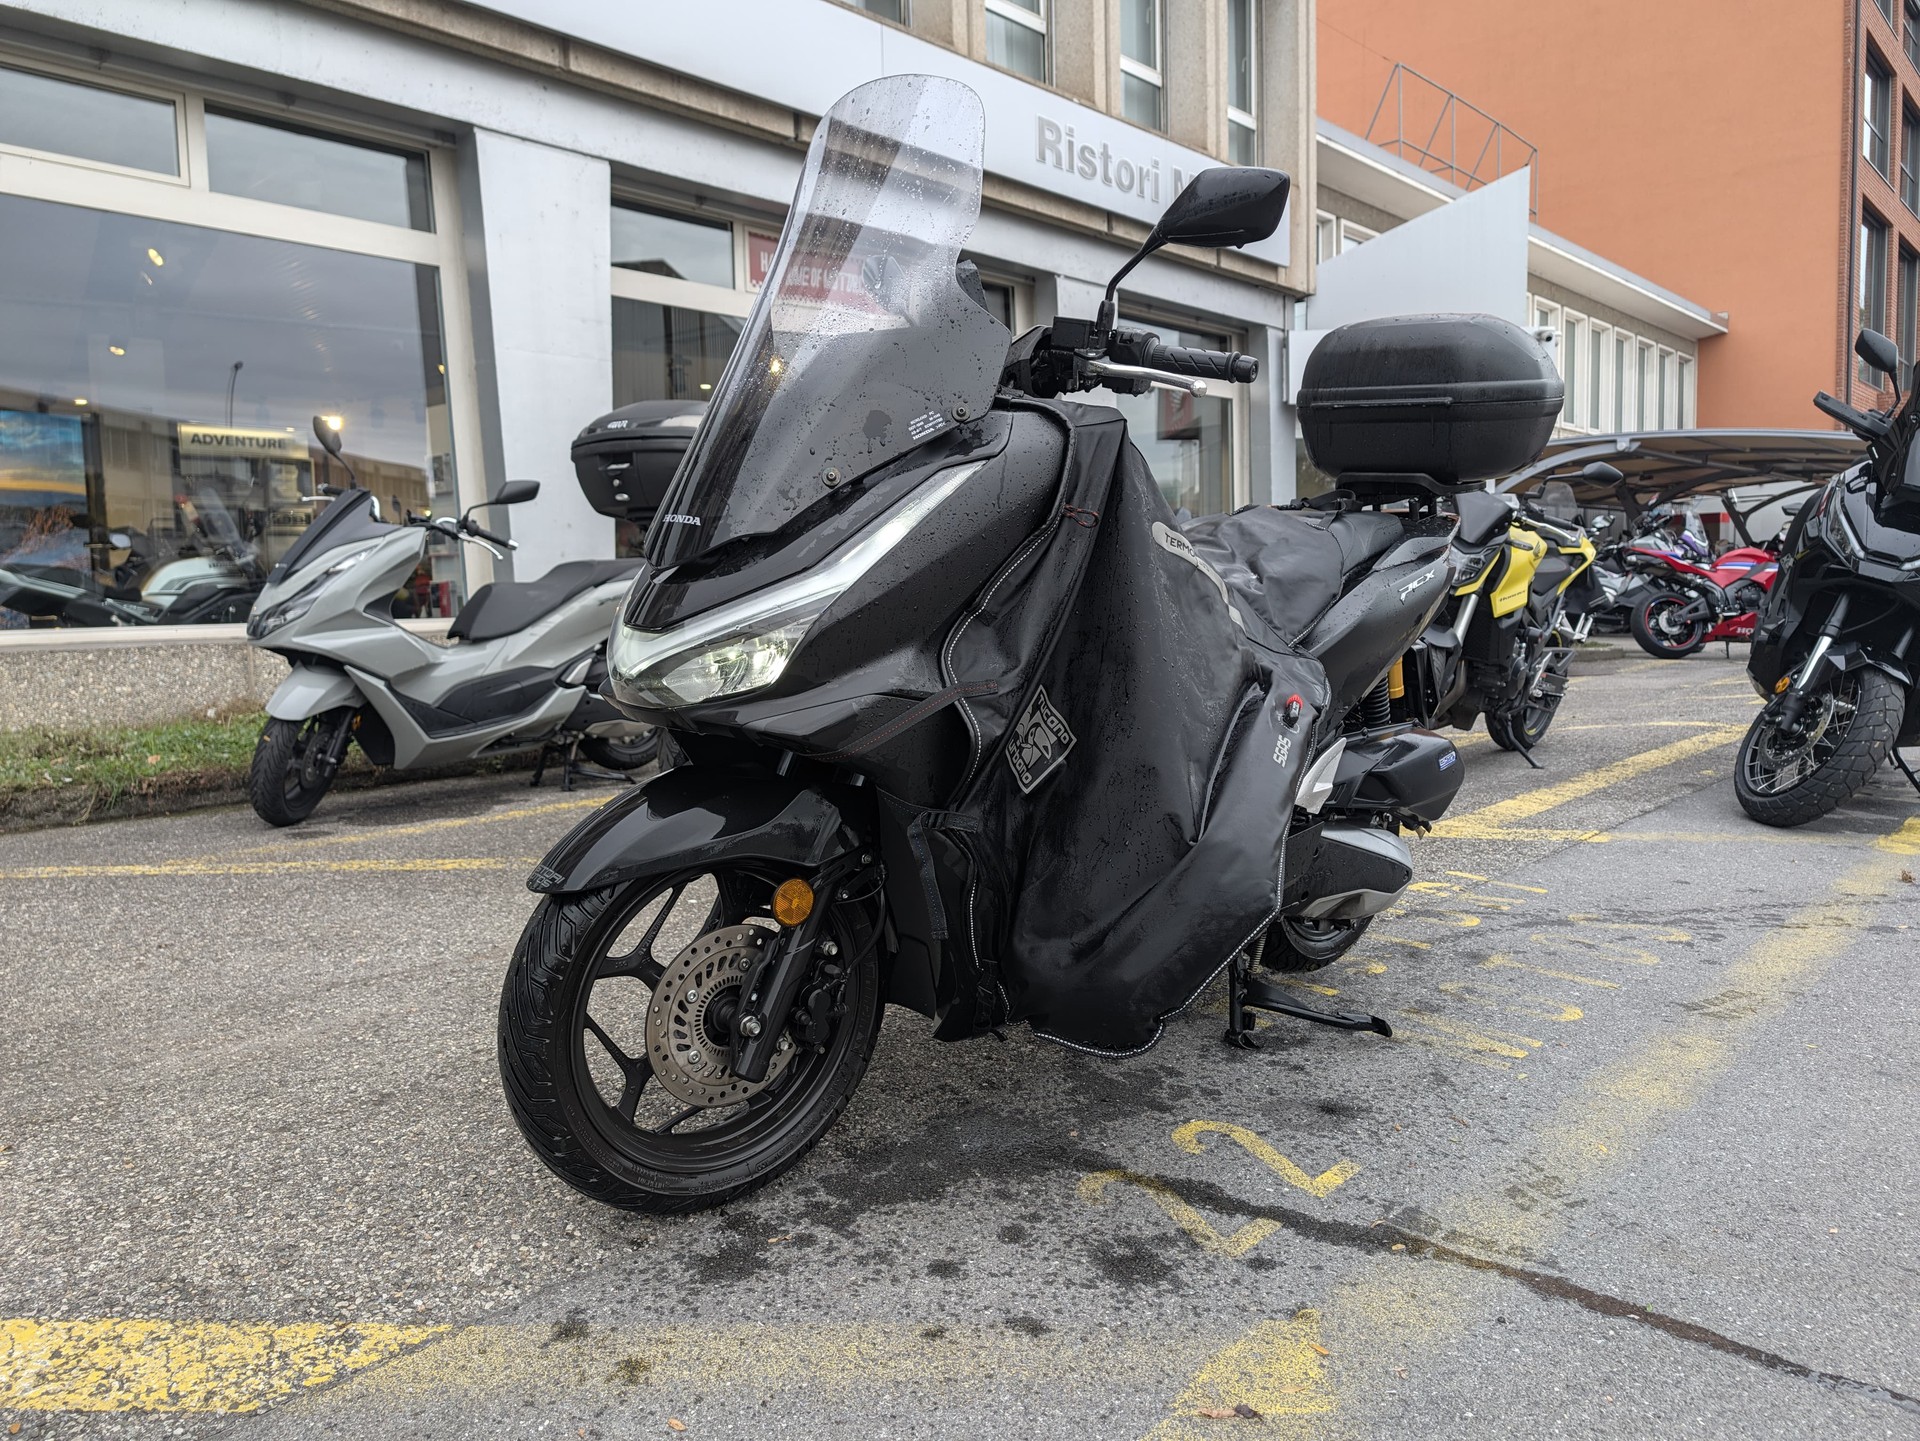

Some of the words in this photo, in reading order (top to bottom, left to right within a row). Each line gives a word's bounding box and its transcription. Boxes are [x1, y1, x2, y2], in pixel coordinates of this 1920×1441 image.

[1035, 113, 1160, 203] Ristori
[191, 433, 287, 449] ADVENTURE
[662, 513, 702, 526] HONDA
[1398, 569, 1435, 602] PCX
